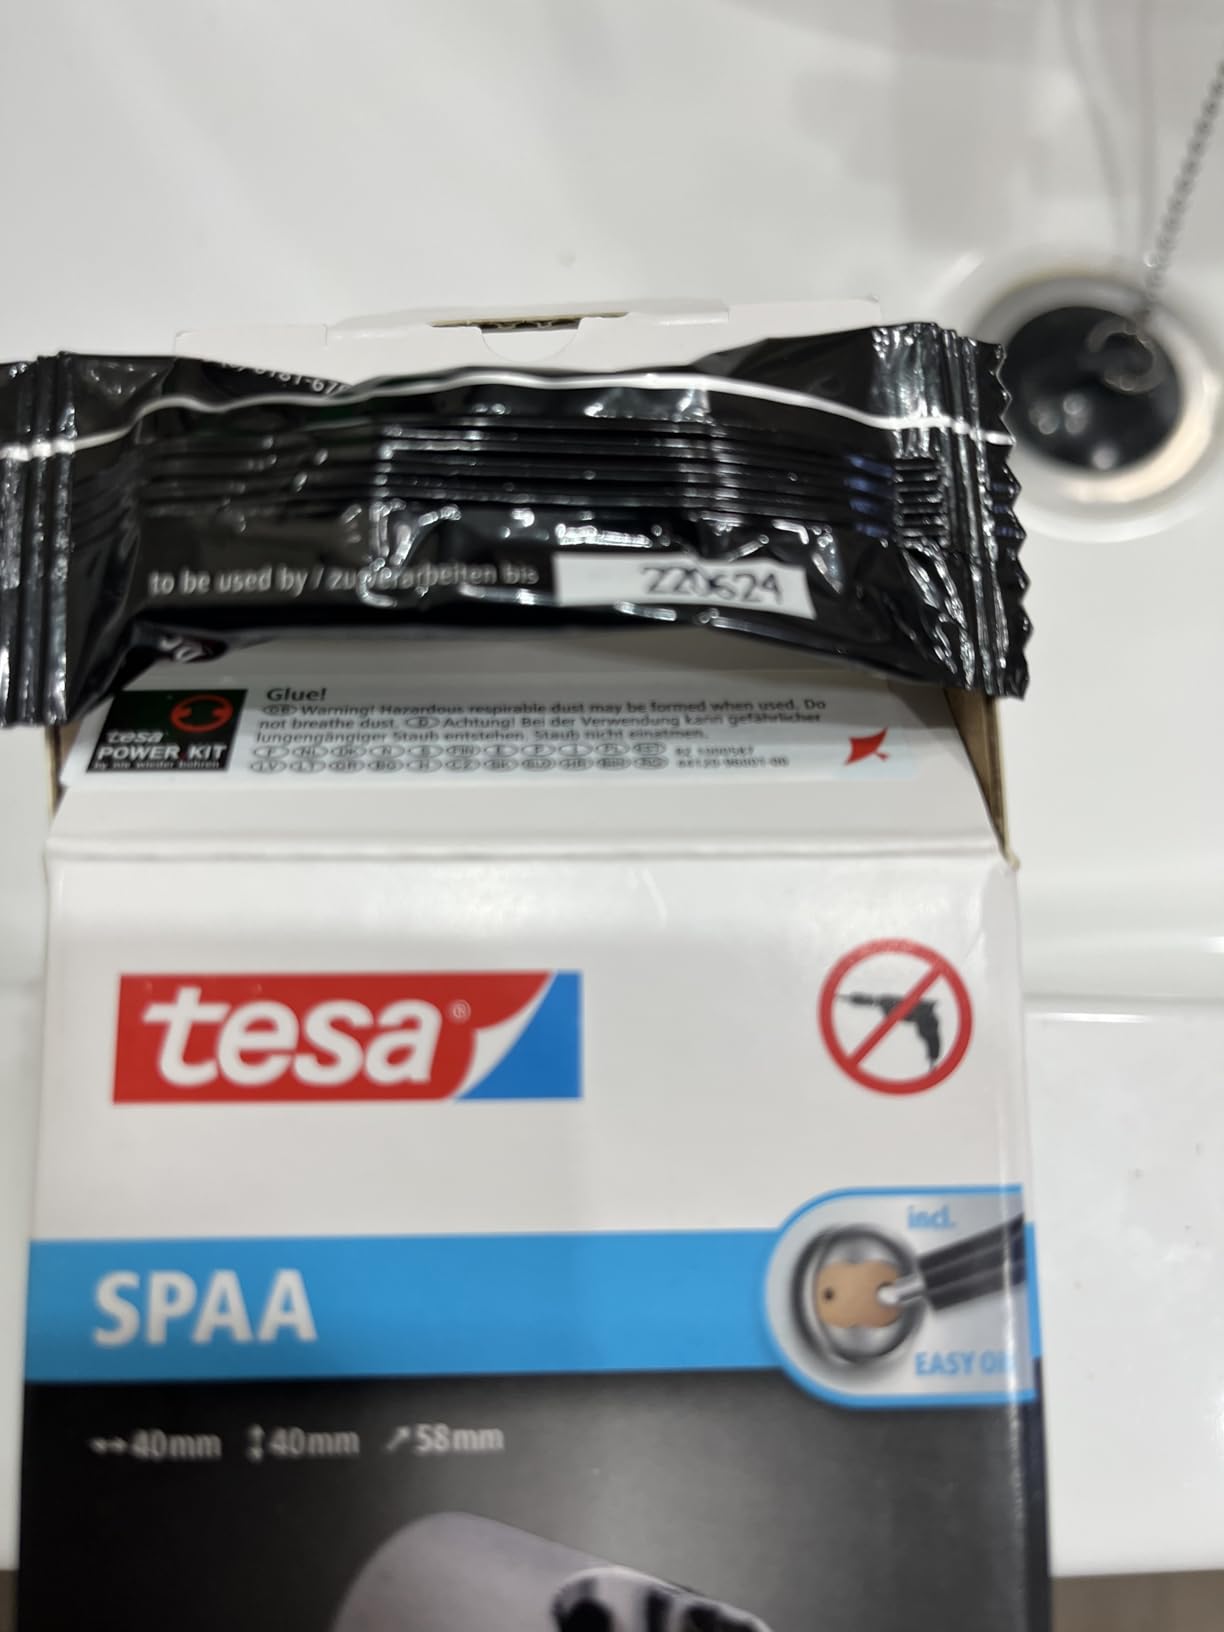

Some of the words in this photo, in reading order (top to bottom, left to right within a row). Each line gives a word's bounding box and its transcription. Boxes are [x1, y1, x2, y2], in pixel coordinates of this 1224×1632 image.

[149, 571, 175, 595] to
[182, 569, 211, 594] be
[218, 566, 273, 593] used
[277, 563, 308, 598] by
[501, 562, 541, 585] bis
[266, 688, 328, 701] Glue!
[301, 704, 375, 719] Warning!
[380, 703, 464, 716] Hazardous
[469, 702, 547, 717] respirable
[552, 701, 584, 714] dust
[590, 702, 623, 716] may
[627, 701, 648, 713] be
[651, 700, 707, 713] formed
[710, 699, 753, 712] when
[804, 699, 827, 710] Do
[260, 719, 287, 729] not
[292, 717, 354, 729] breathe
[443, 716, 516, 730] Achtung!
[522, 716, 546, 728] Bei
[552, 715, 576, 727] der
[581, 714, 681, 728] Verwendung
[684, 713, 724, 725] kann
[107, 730, 164, 744] tesa
[392, 730, 439, 742] Staub
[535, 729, 580, 741] Staub
[584, 728, 623, 740] nicht
[98, 745, 180, 760] POWER
[188, 744, 227, 760] KIT
[142, 986, 443, 1087] tesa
[907, 1204, 957, 1230] incl.
[93, 1267, 319, 1346] SPAA
[914, 1351, 976, 1376] EASY
